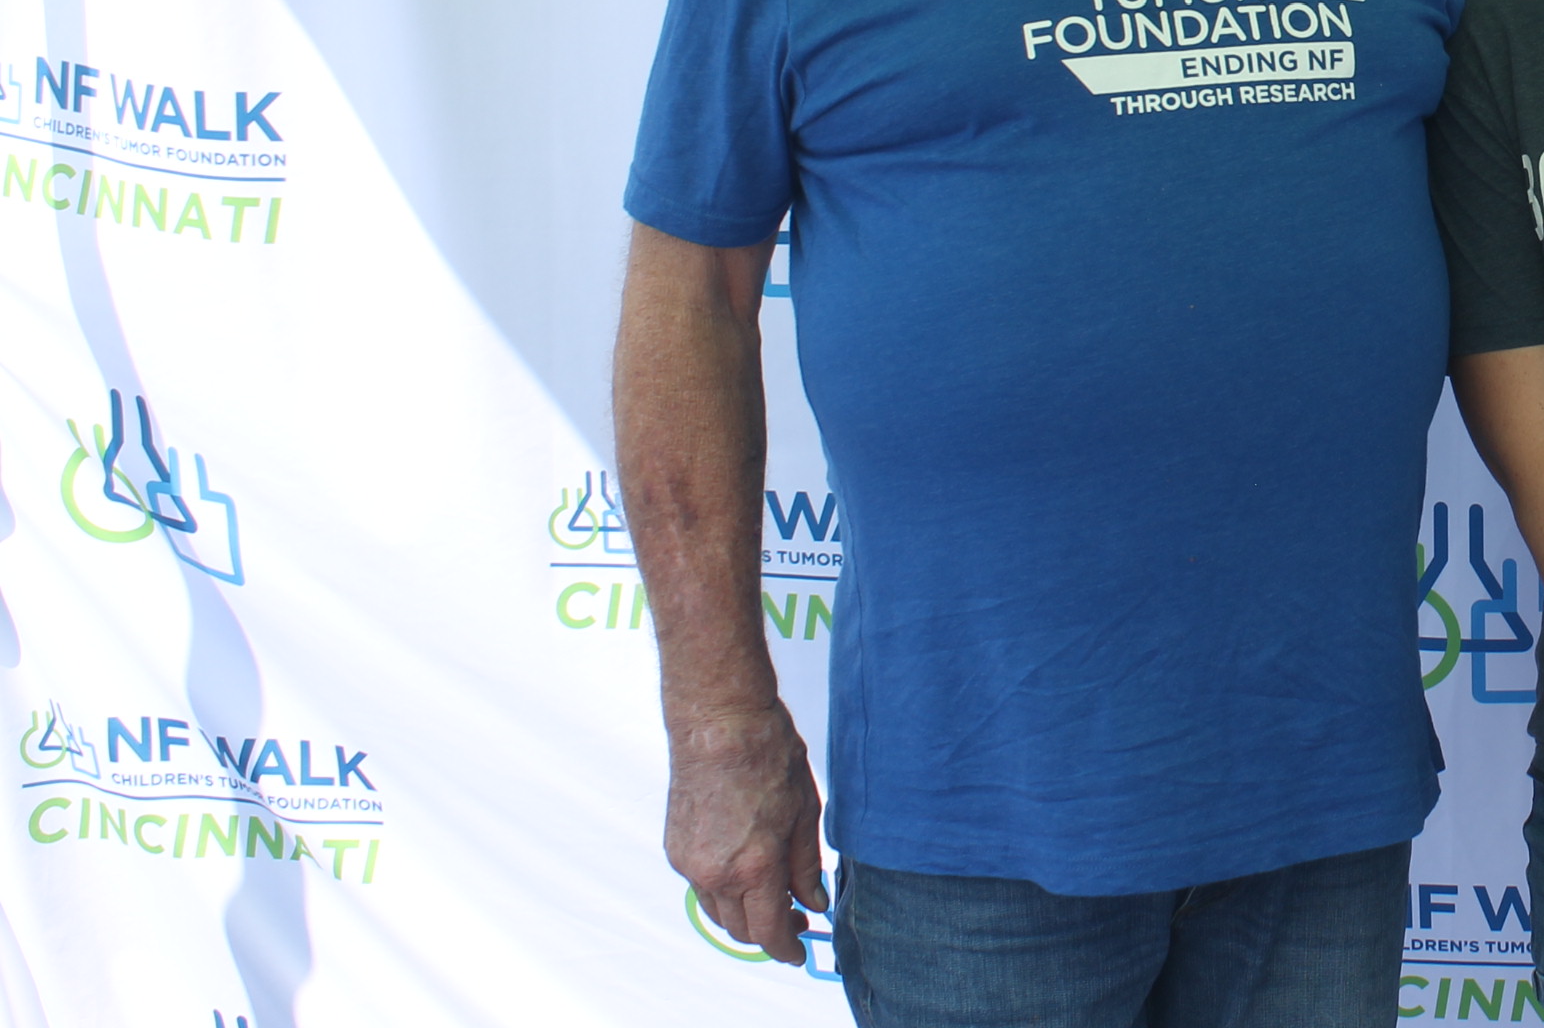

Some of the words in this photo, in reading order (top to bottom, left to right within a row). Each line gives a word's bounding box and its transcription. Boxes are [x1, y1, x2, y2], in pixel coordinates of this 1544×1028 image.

[1022, 2, 1353, 61] FOUNDATION
[1180, 50, 1298, 80] ENDING
[1308, 48, 1345, 72] NF
[35, 55, 100, 114] NF
[110, 73, 284, 142] WALK
[1109, 87, 1234, 117] THROUGH
[1240, 81, 1356, 105] RESEARCH
[166, 147, 287, 168] FOUNDATION
[2, 153, 283, 245] NCINNATI
[777, 550, 844, 567] TUMOR
[107, 715, 190, 763] NF
[198, 726, 378, 792] WALK
[111, 772, 214, 787] CHILDREN'S
[268, 795, 384, 813] FOUNDATION
[28, 796, 381, 885] CINCINNATI
